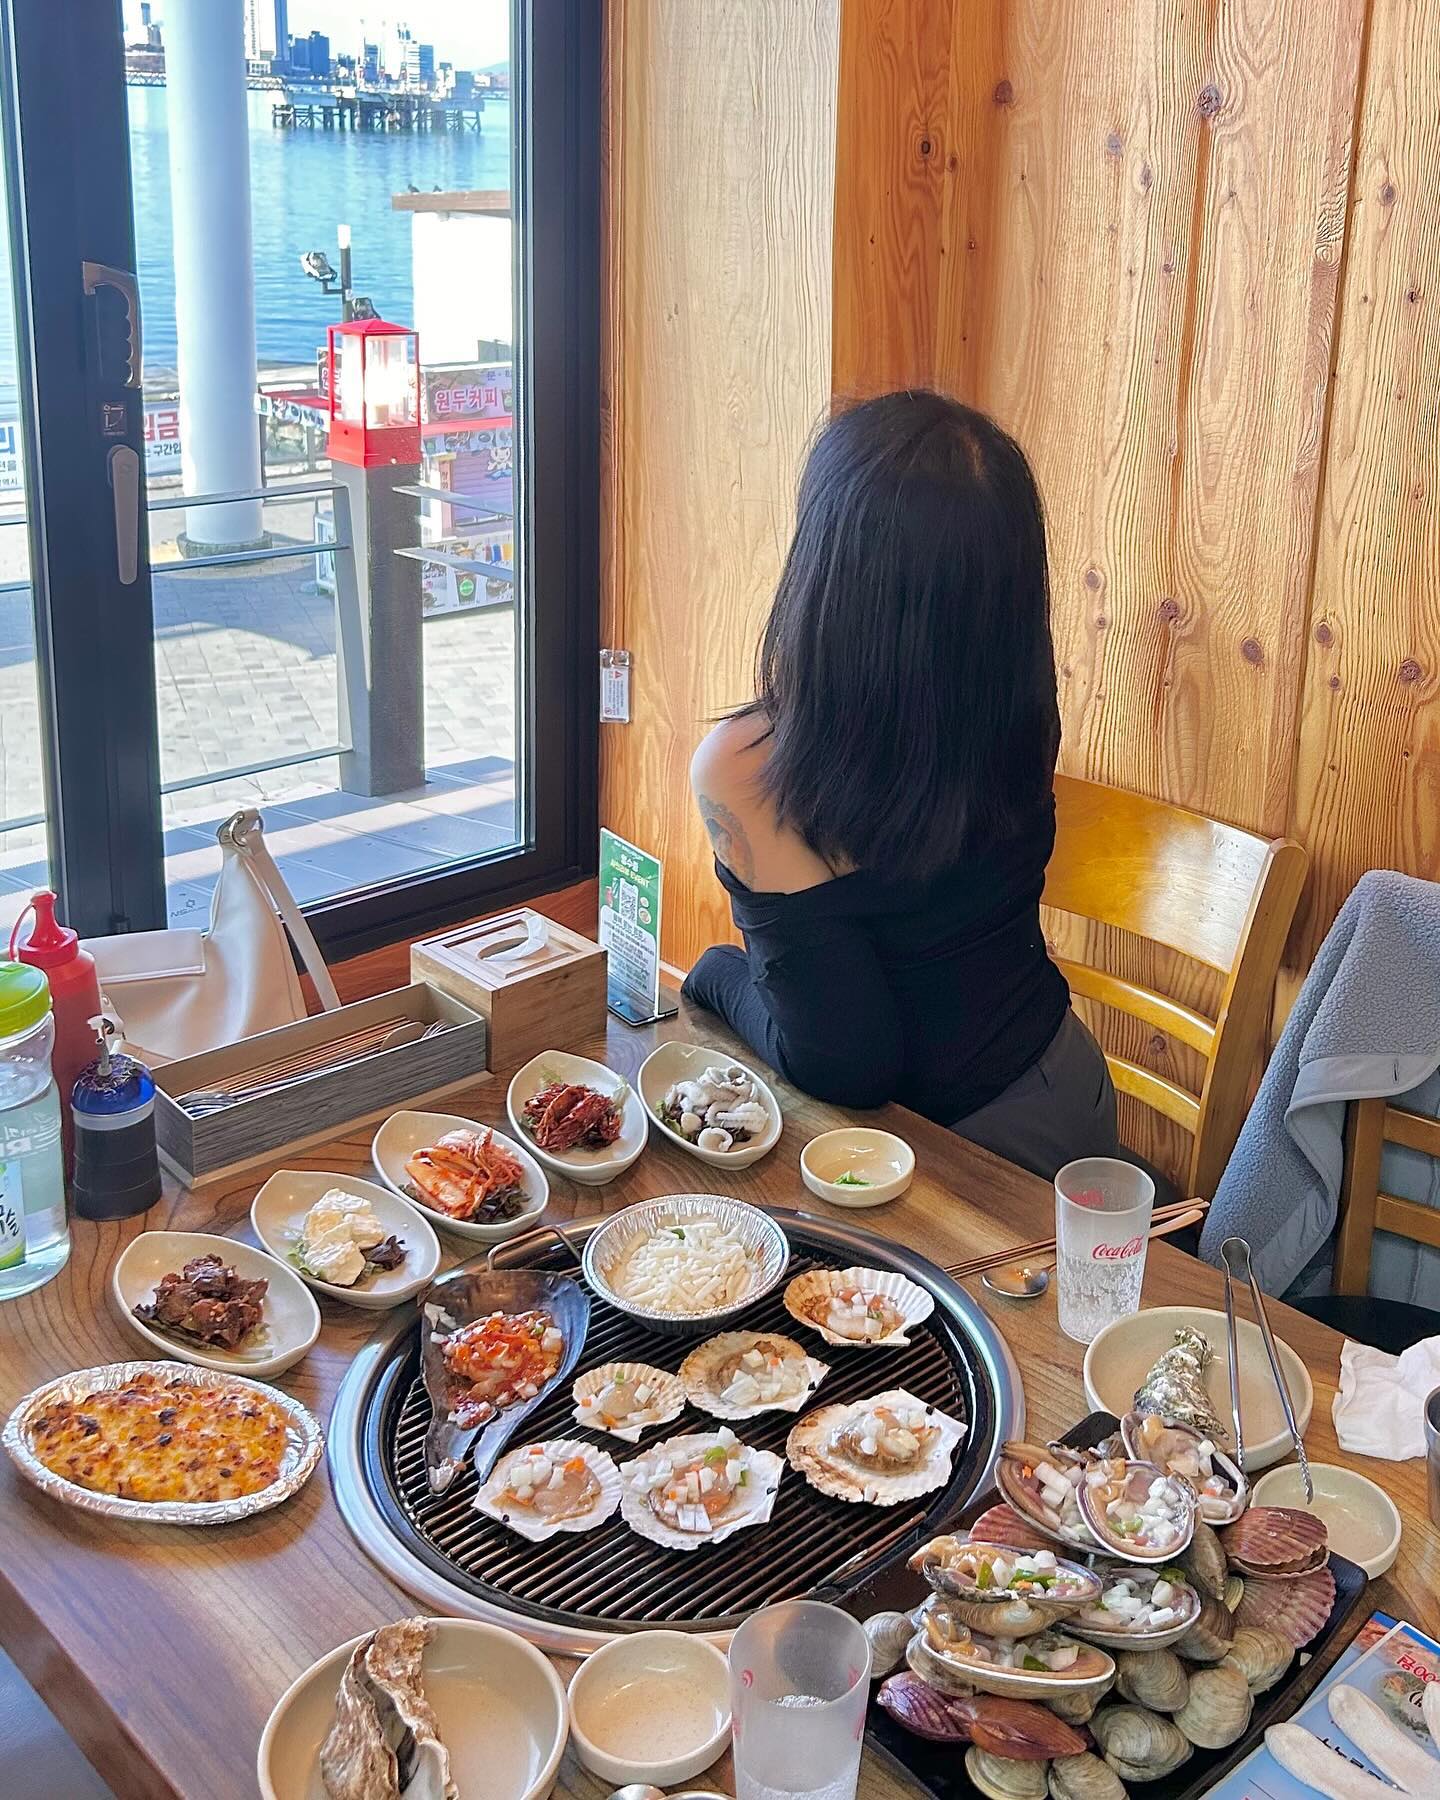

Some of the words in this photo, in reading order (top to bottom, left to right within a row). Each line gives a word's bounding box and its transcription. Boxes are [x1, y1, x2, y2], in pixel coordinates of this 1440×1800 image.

[435, 386, 499, 413] 원두커피
[1091, 1234, 1145, 1261] Coca-Cola
[1396, 1653, 1440, 1684] 00원
